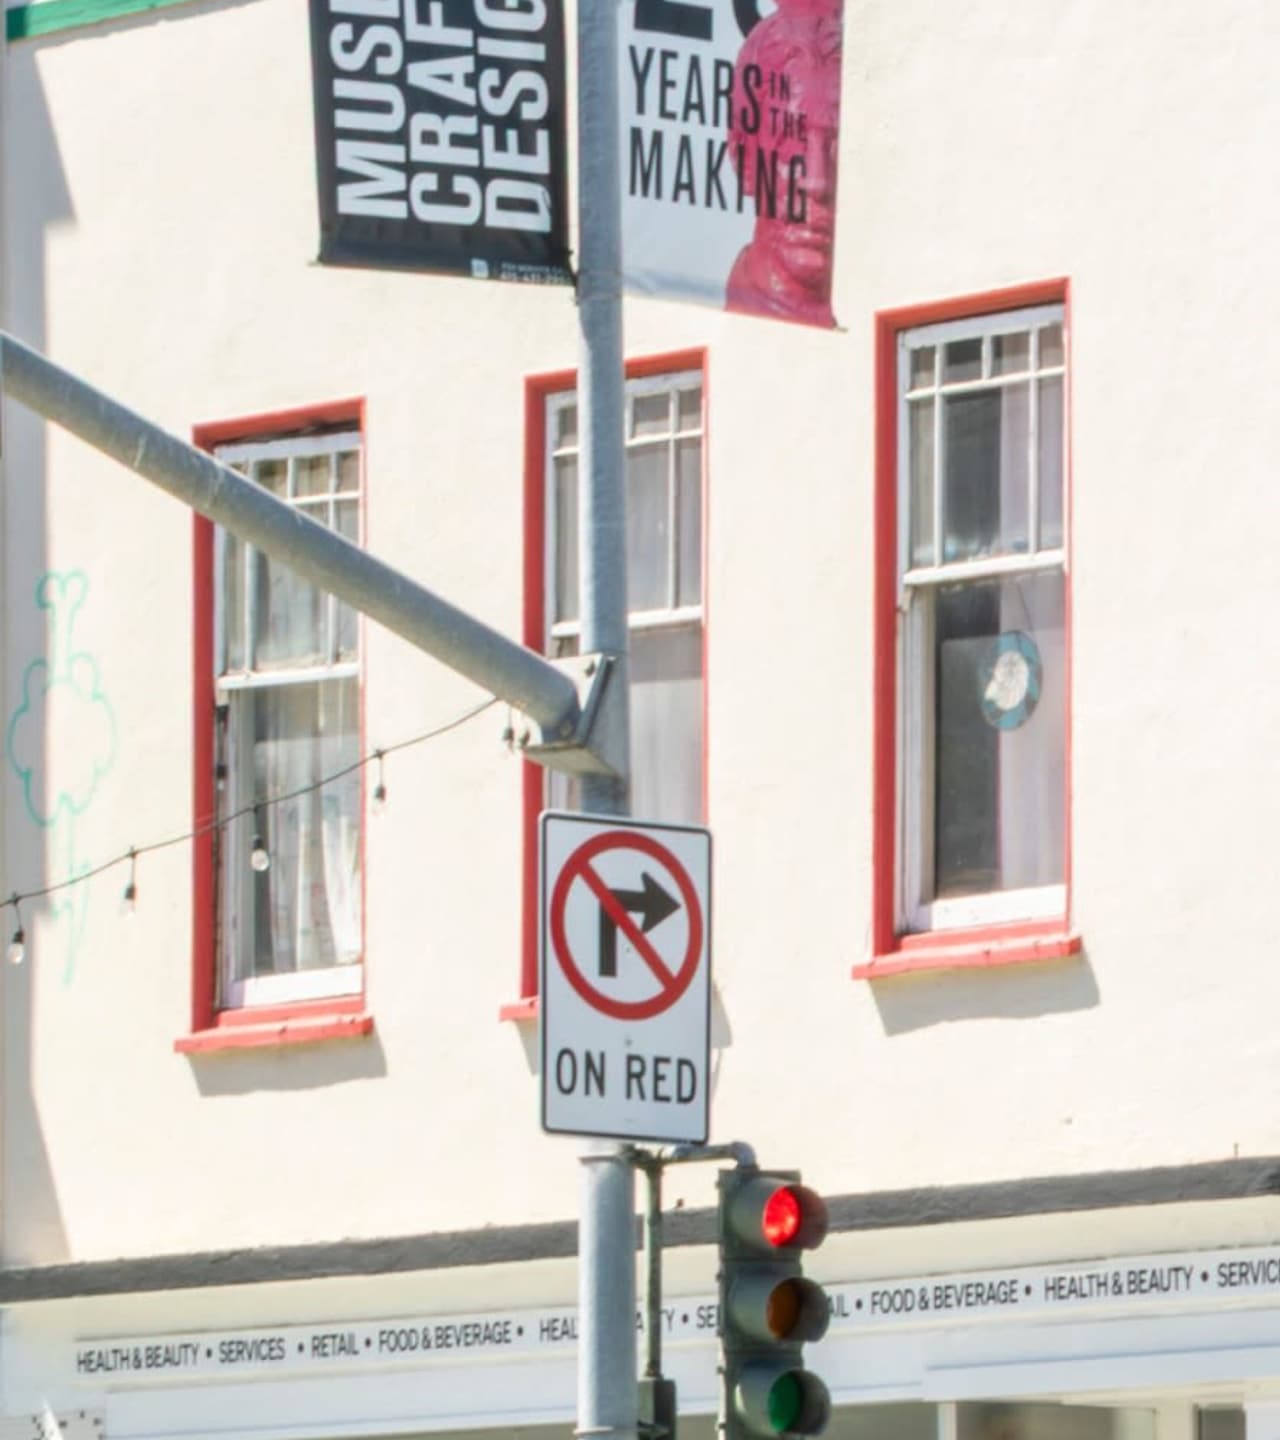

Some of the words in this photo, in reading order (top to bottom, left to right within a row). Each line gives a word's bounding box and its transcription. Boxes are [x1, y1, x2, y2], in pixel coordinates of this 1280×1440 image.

[629, 45, 762, 134] YEARS
[769, 71, 791, 101] IN
[768, 107, 807, 142] THE
[629, 126, 807, 224] MAKING
[556, 1048, 606, 1098] ON
[625, 1054, 697, 1104] RED
[77, 1348, 131, 1372] HEALTH
[145, 1343, 199, 1368] BEAUTY
[219, 1337, 286, 1363] SERVICES
[311, 1333, 359, 1357] RETAIL
[378, 1328, 420, 1353] FOOD
[434, 1321, 512, 1349] BEVERAGE
[539, 1317, 578, 1342] HEAL
[871, 1287, 915, 1314] FOOD
[934, 1280, 1018, 1309] BEVERAGE
[1044, 1273, 1109, 1301] HEALTH
[1127, 1265, 1194, 1294] BEAUTY
